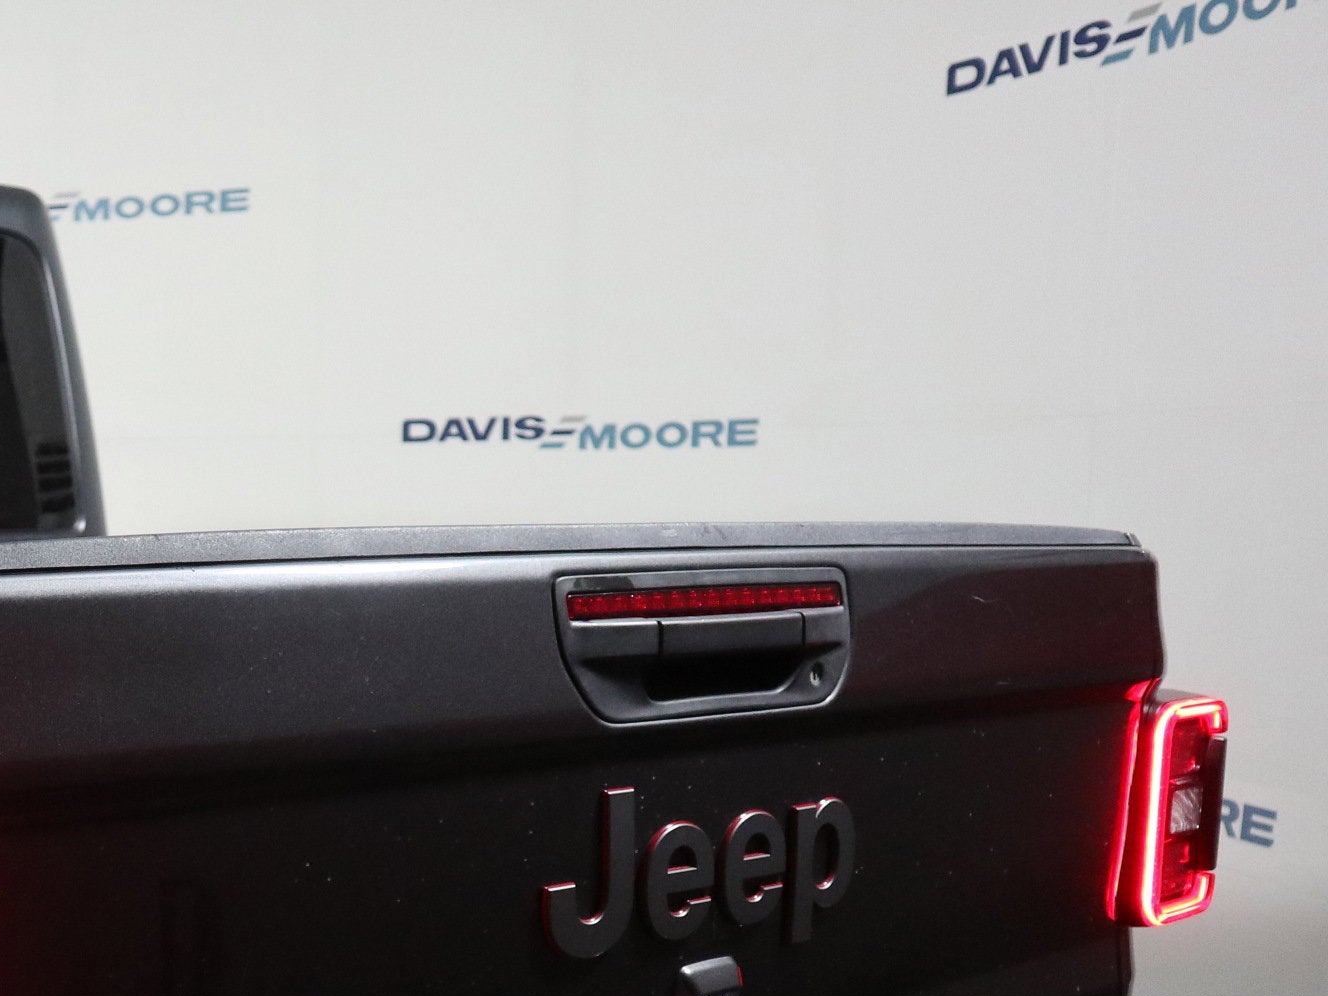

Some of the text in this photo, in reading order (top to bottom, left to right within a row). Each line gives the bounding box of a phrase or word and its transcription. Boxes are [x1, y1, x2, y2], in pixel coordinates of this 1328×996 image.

[946, 0, 1298, 96] DAVIS MOO
[74, 188, 250, 221] MOORE
[402, 415, 760, 449] DAVIS MOORE
[543, 786, 856, 958] Jeep
